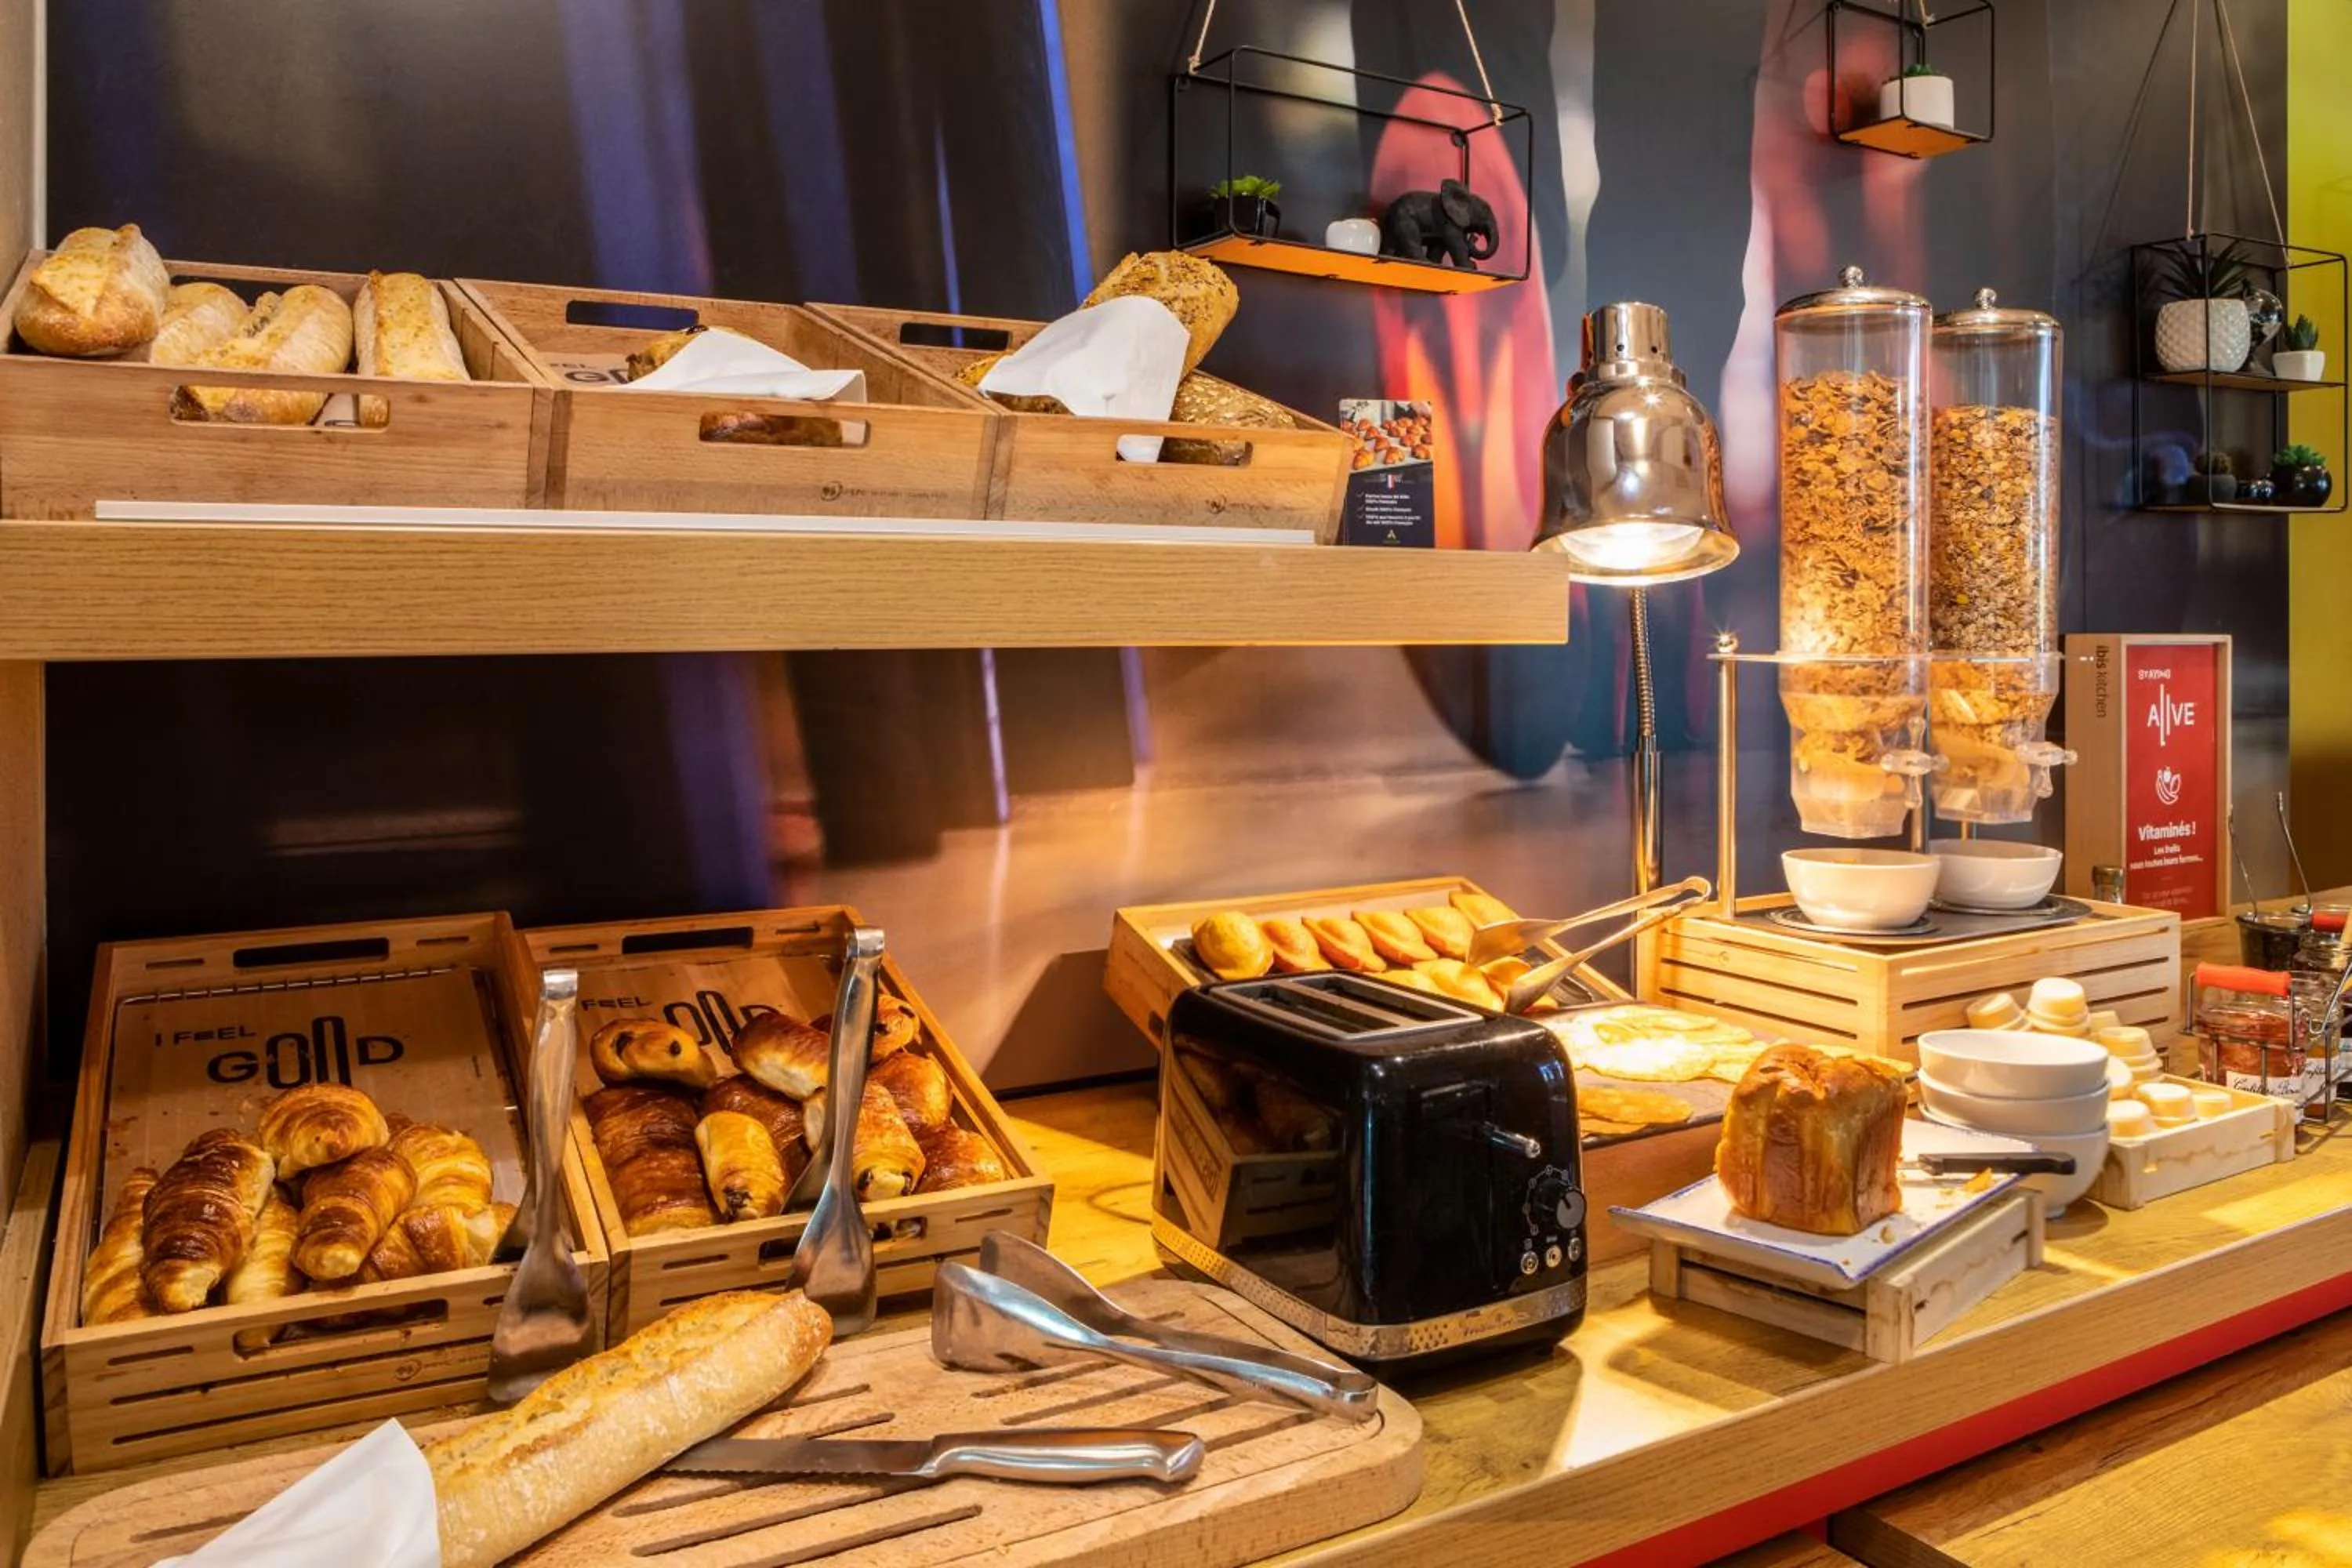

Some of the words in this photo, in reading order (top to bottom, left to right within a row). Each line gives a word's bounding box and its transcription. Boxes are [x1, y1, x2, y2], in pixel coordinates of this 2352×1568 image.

[2096, 645, 2109, 669] ibis
[2096, 670, 2107, 718] kitchen
[173, 1025, 258, 1046] FEEL
[207, 1015, 405, 1090] GOOD
